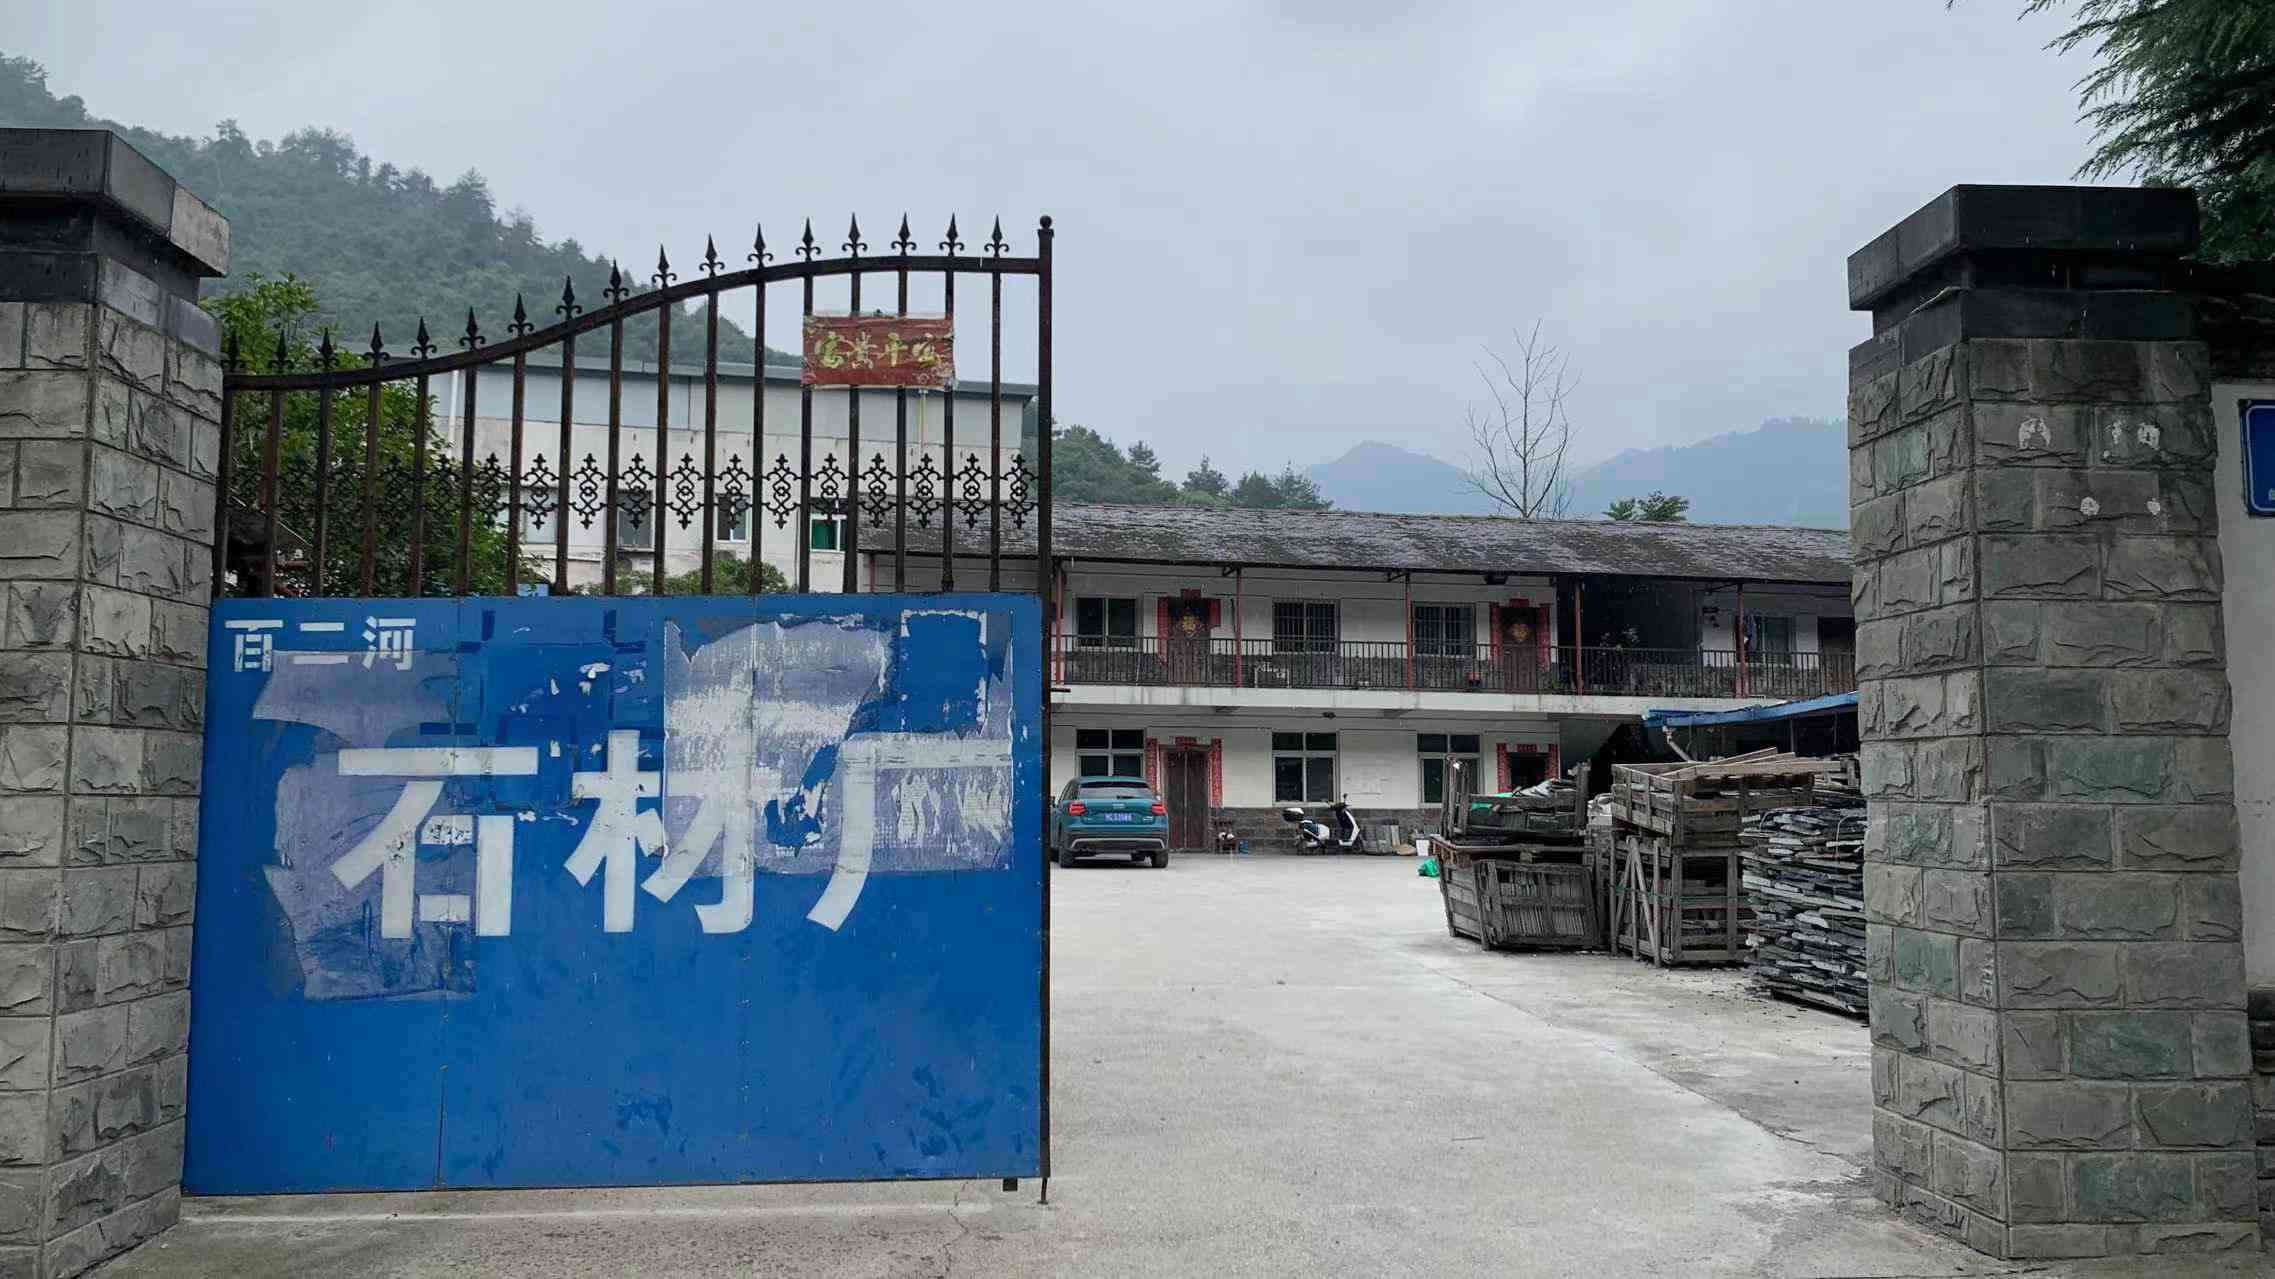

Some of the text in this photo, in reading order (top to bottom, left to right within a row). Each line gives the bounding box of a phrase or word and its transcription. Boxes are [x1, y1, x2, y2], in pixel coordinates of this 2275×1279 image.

[225, 615, 417, 672] 百二河
[331, 730, 1013, 939] 石材厂
